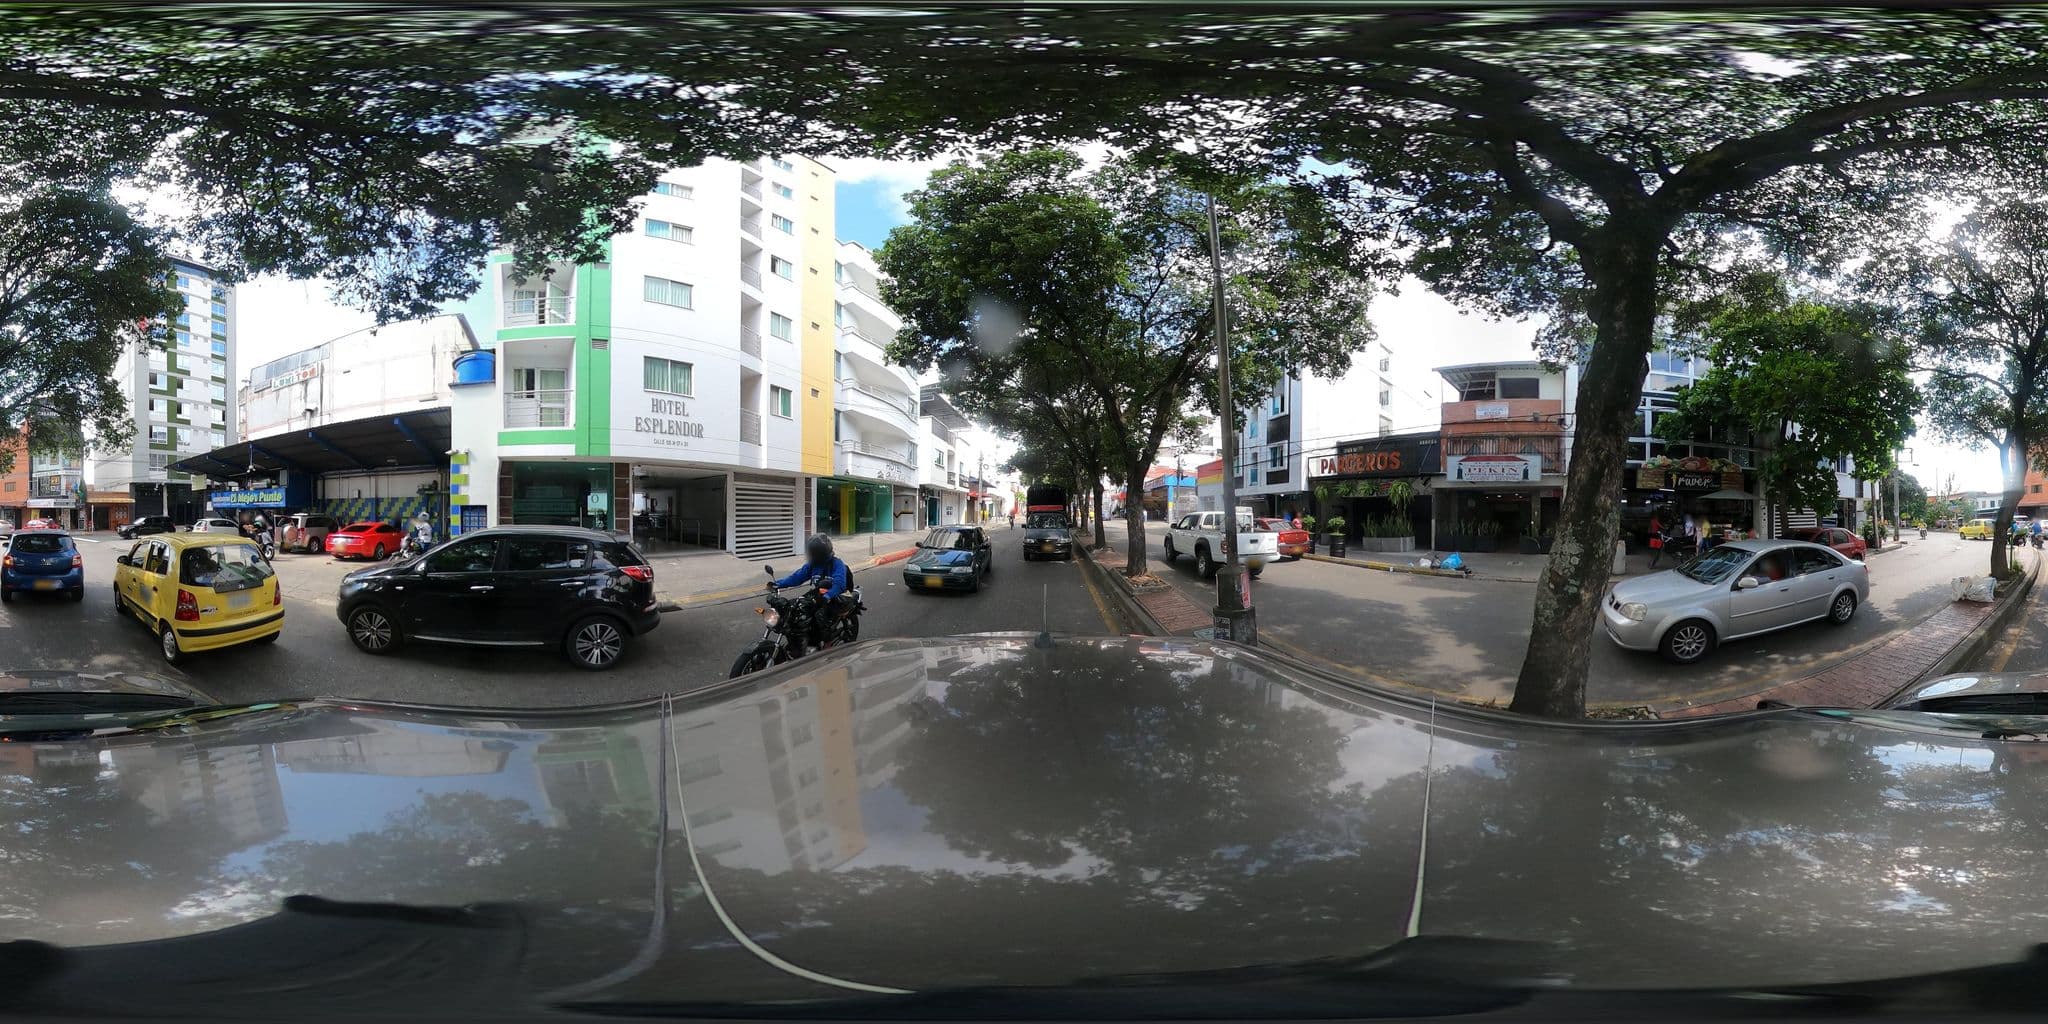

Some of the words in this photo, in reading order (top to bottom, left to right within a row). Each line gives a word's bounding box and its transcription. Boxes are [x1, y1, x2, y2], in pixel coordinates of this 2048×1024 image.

[651, 398, 689, 417] HOTEL
[635, 416, 704, 439] ESPLENDOR
[260, 490, 283, 502] Punto
